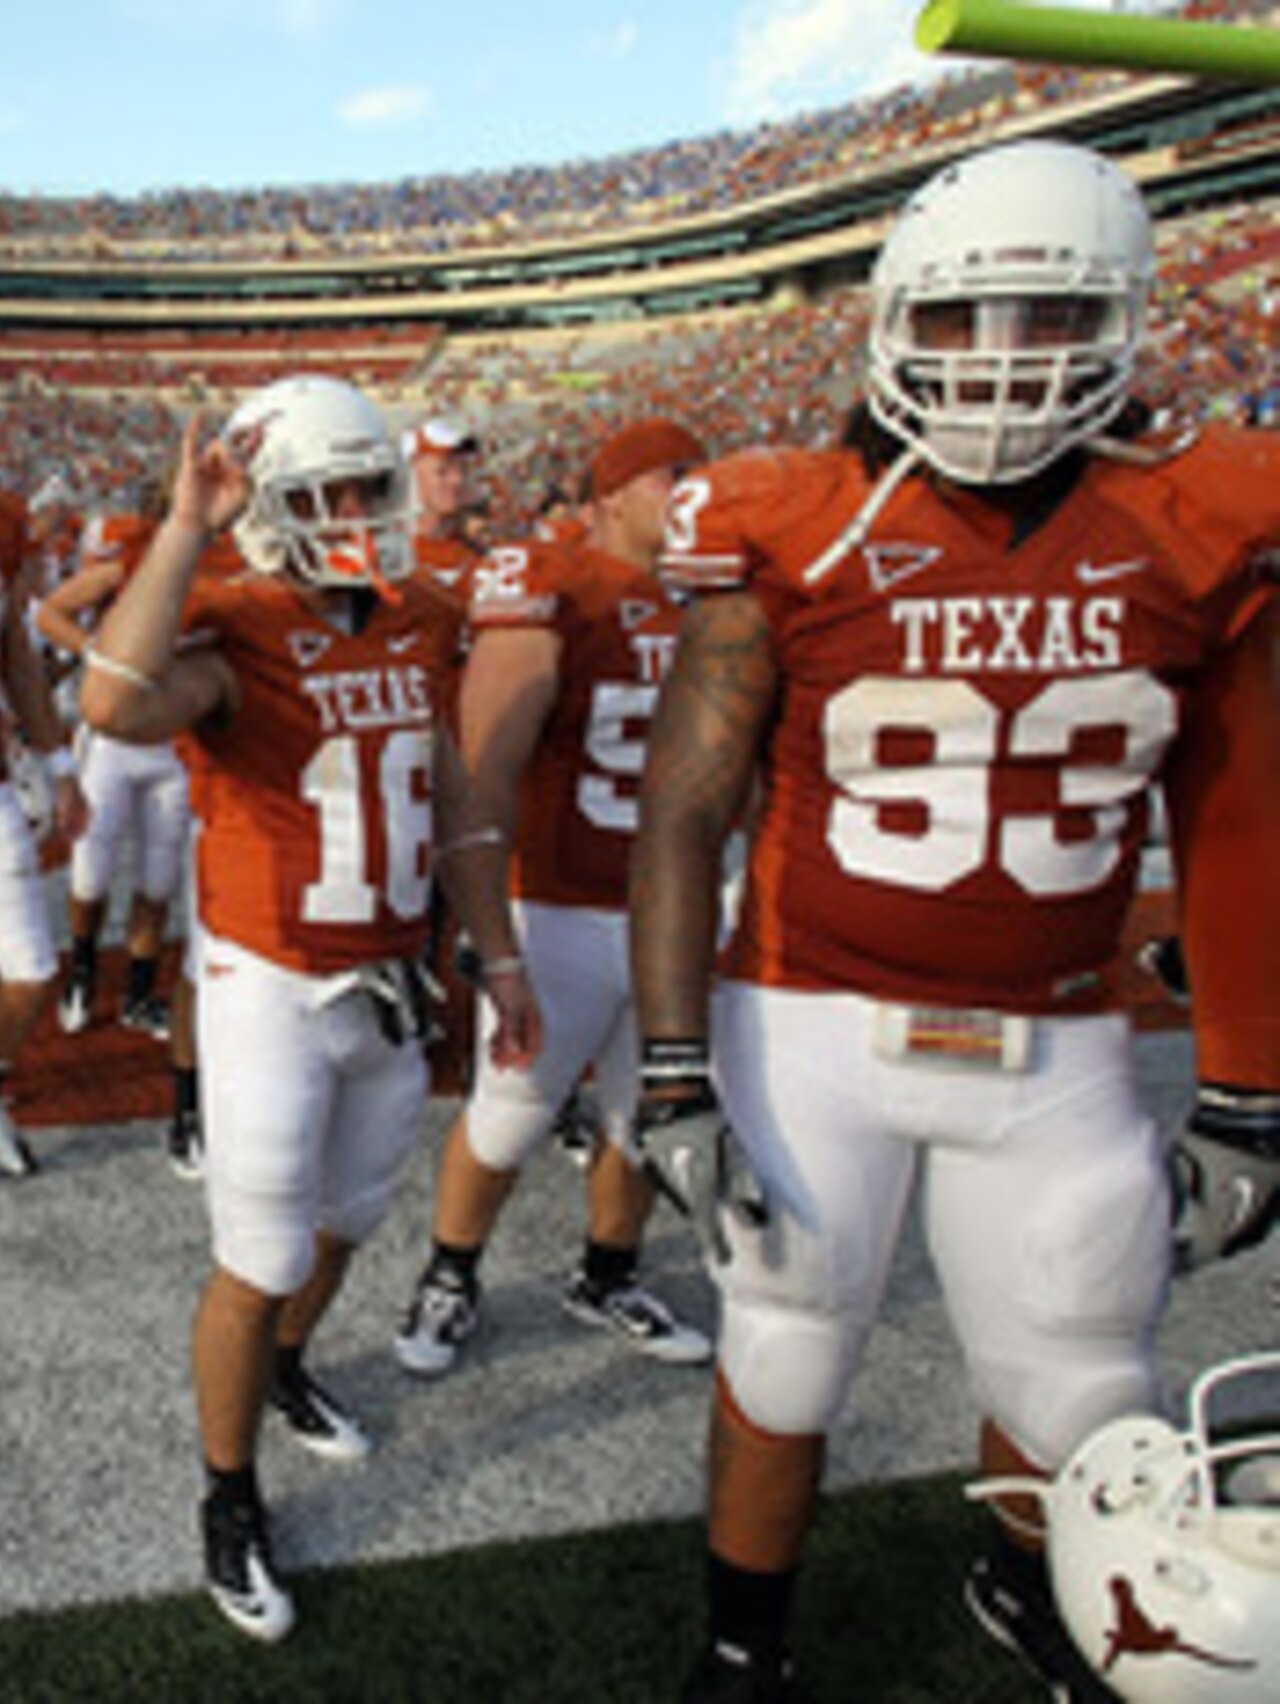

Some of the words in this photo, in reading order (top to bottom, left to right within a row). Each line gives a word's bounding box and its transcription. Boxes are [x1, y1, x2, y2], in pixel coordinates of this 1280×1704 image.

[889, 596, 1126, 673] TEXAS
[300, 662, 432, 732] TEXAS
[823, 666, 1181, 898] 93
